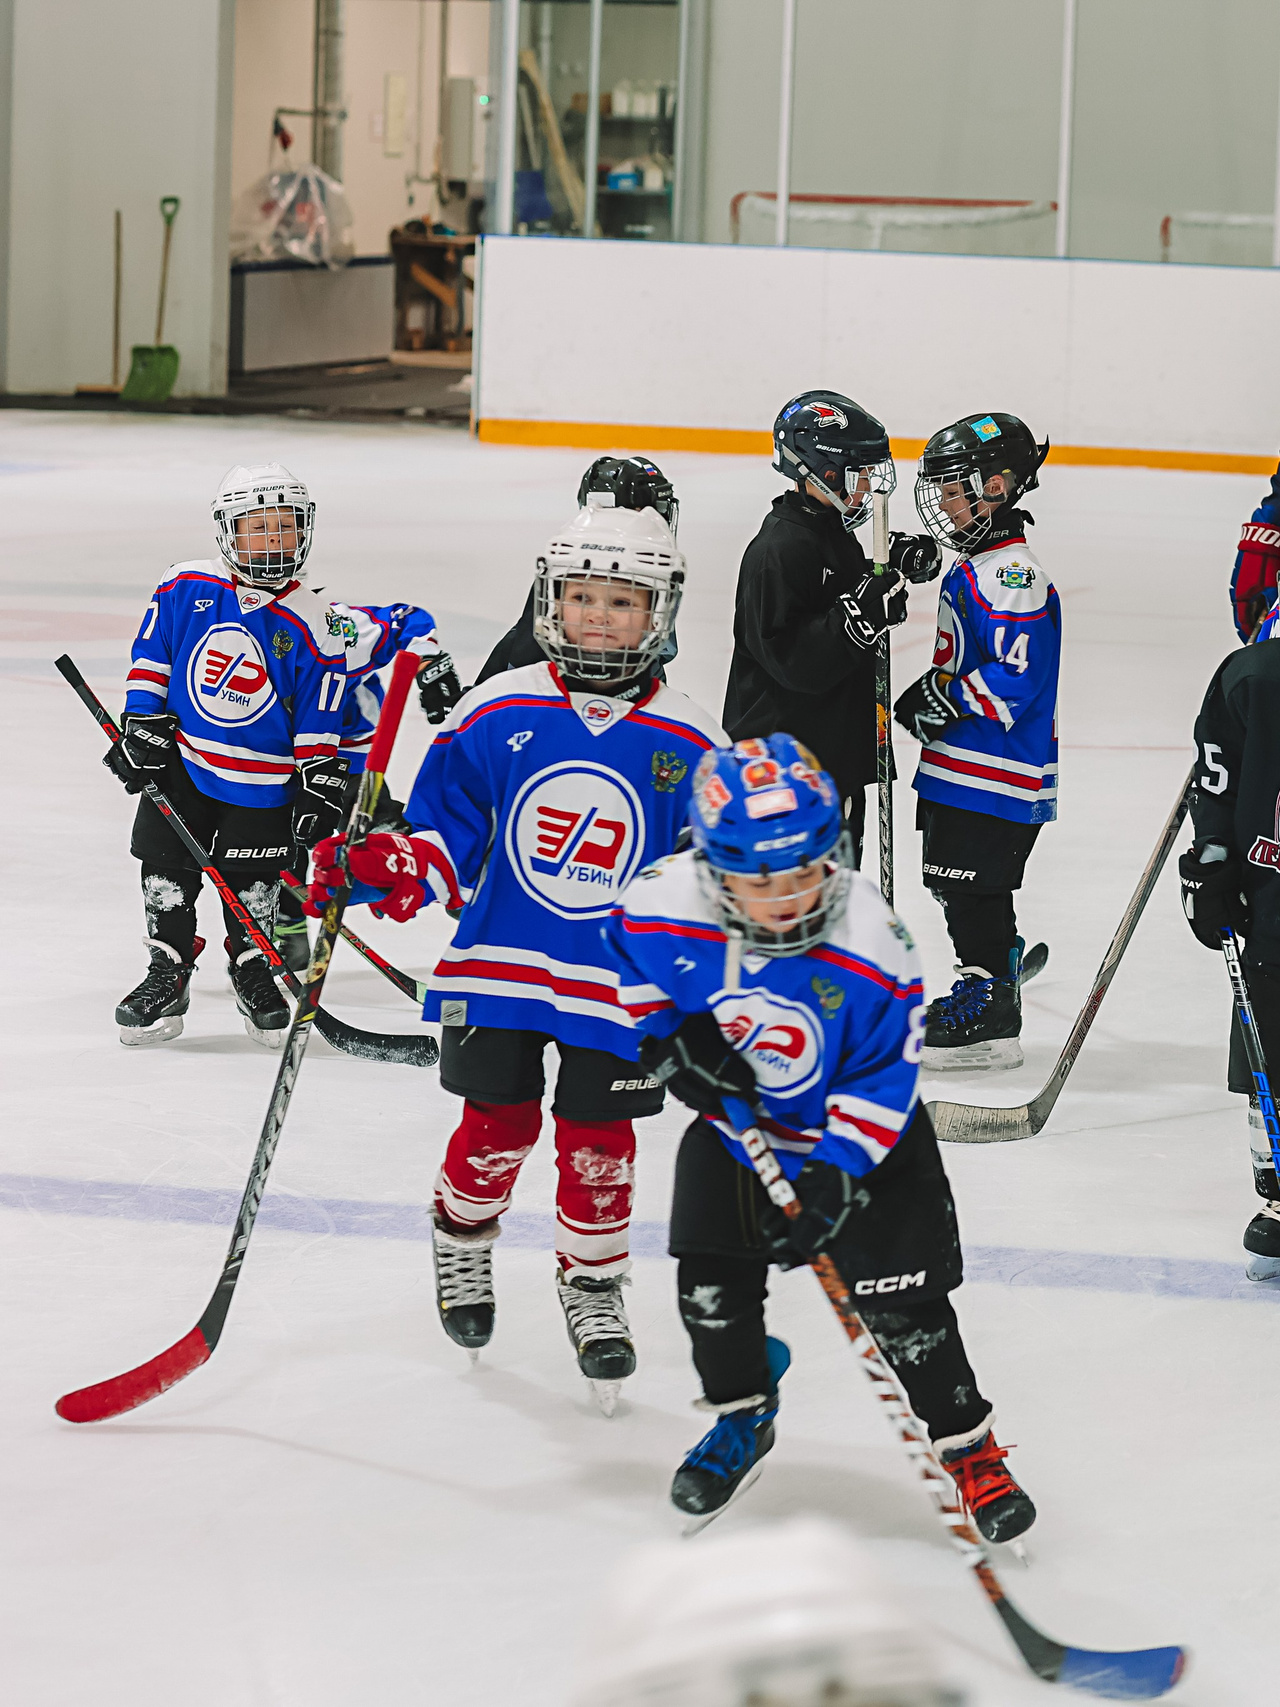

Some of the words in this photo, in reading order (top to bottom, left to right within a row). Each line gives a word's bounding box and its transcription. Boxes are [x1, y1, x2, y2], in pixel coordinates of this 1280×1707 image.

[252, 483, 285, 493] BAUER
[580, 542, 626, 553] BAUER
[221, 688, 251, 708] УБИН
[318, 671, 347, 711] 17
[225, 846, 288, 859] BAUER
[566, 865, 613, 889] УБИН
[923, 862, 977, 882] BAUER
[202, 866, 282, 967] FISCHER
[755, 1051, 792, 1074] БИН
[855, 1270, 926, 1295] CCM
